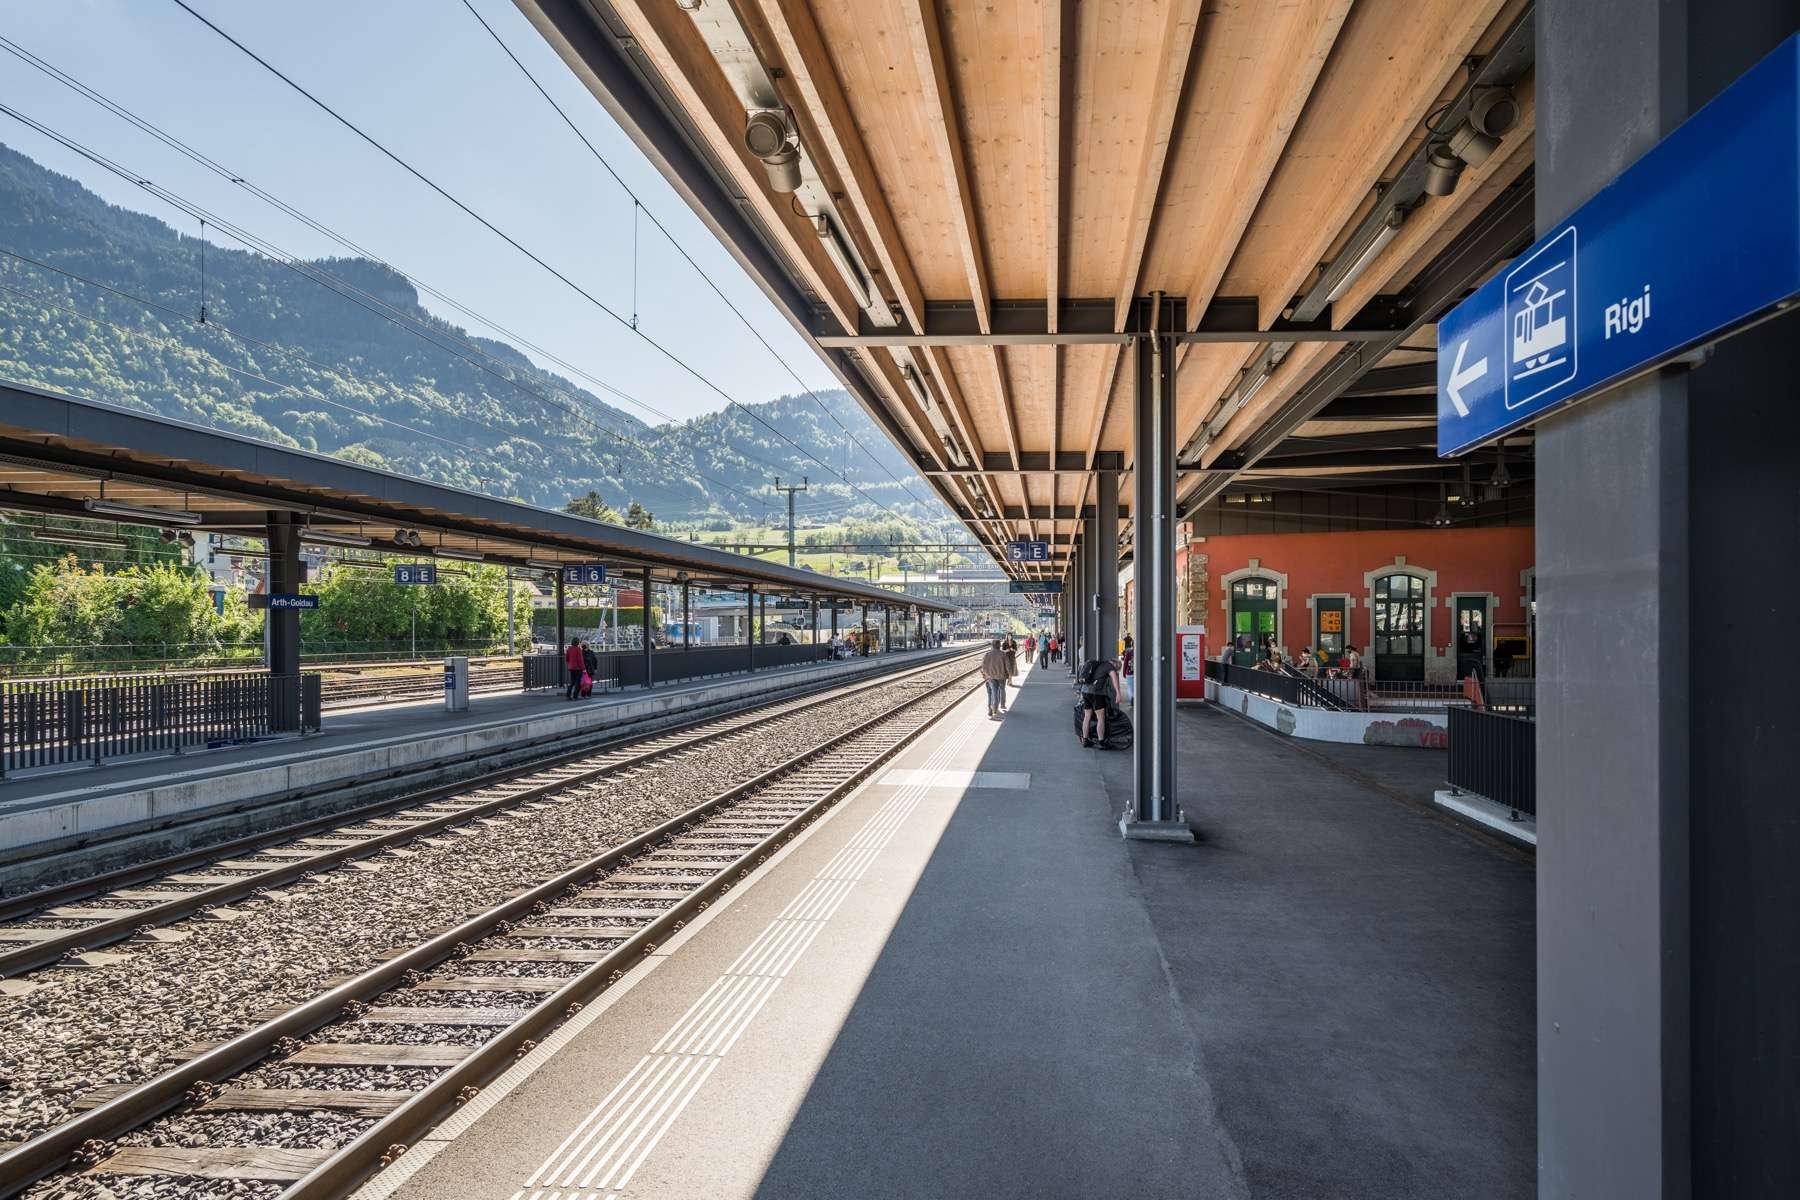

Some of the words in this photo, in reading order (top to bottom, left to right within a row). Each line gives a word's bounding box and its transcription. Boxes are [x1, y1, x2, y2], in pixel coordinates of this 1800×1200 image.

[1605, 284, 1650, 340] Rigi
[1013, 548, 1021, 559] 5
[1033, 548, 1042, 559] E
[401, 571, 409, 582] 8
[420, 570, 429, 582] E
[570, 570, 578, 581] E
[590, 570, 599, 581] 6
[271, 598, 313, 607] Arth-Goldau
